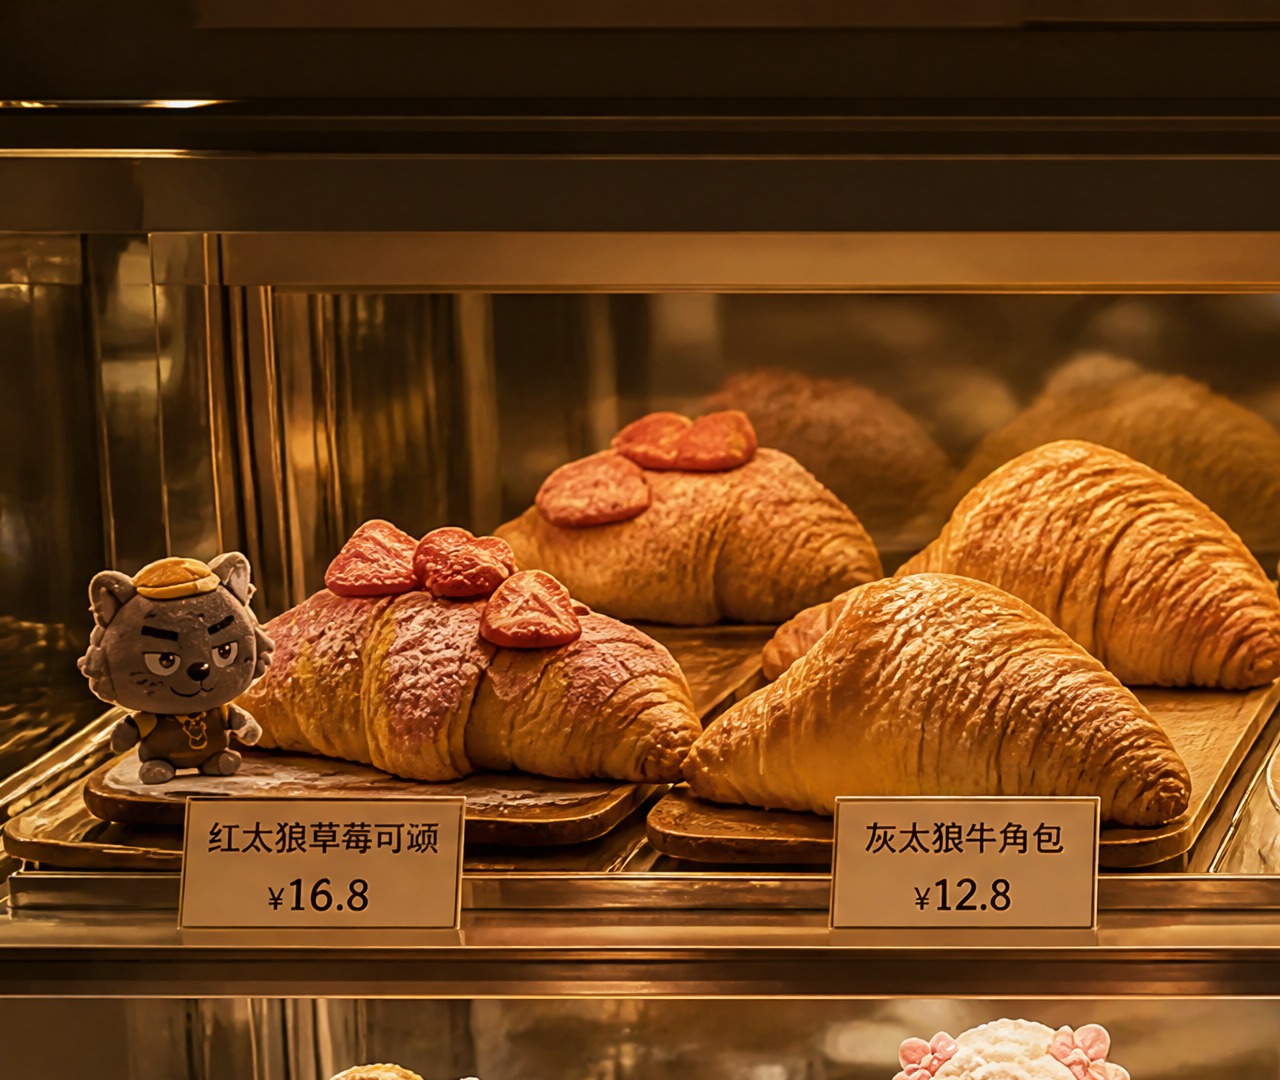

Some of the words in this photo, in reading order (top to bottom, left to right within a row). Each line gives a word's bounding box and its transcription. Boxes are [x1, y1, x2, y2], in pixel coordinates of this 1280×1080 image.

[864, 821, 1064, 854] 灰太狼牛角包
[267, 877, 369, 912] ¥16.8
[913, 877, 1011, 912] ¥12.8
